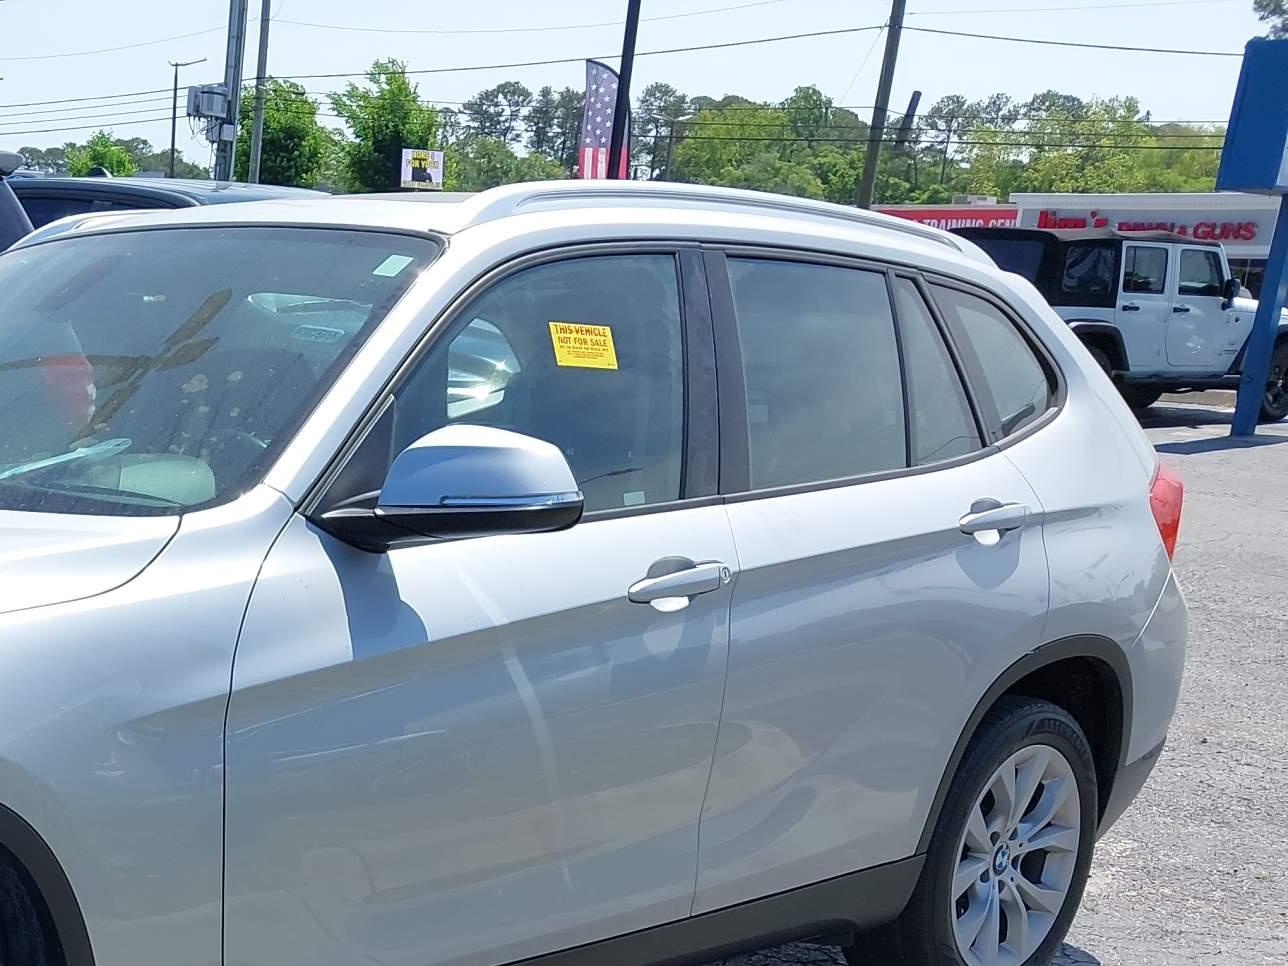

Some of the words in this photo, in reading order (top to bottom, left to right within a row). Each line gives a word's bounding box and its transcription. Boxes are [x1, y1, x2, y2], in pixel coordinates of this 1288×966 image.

[1192, 221, 1258, 241] GUNS
[554, 324, 573, 335] THIS
[573, 326, 608, 337] VEHICLE
[557, 336, 572, 344] NOT
[573, 337, 588, 346] FOR
[590, 338, 608, 347] SALE
